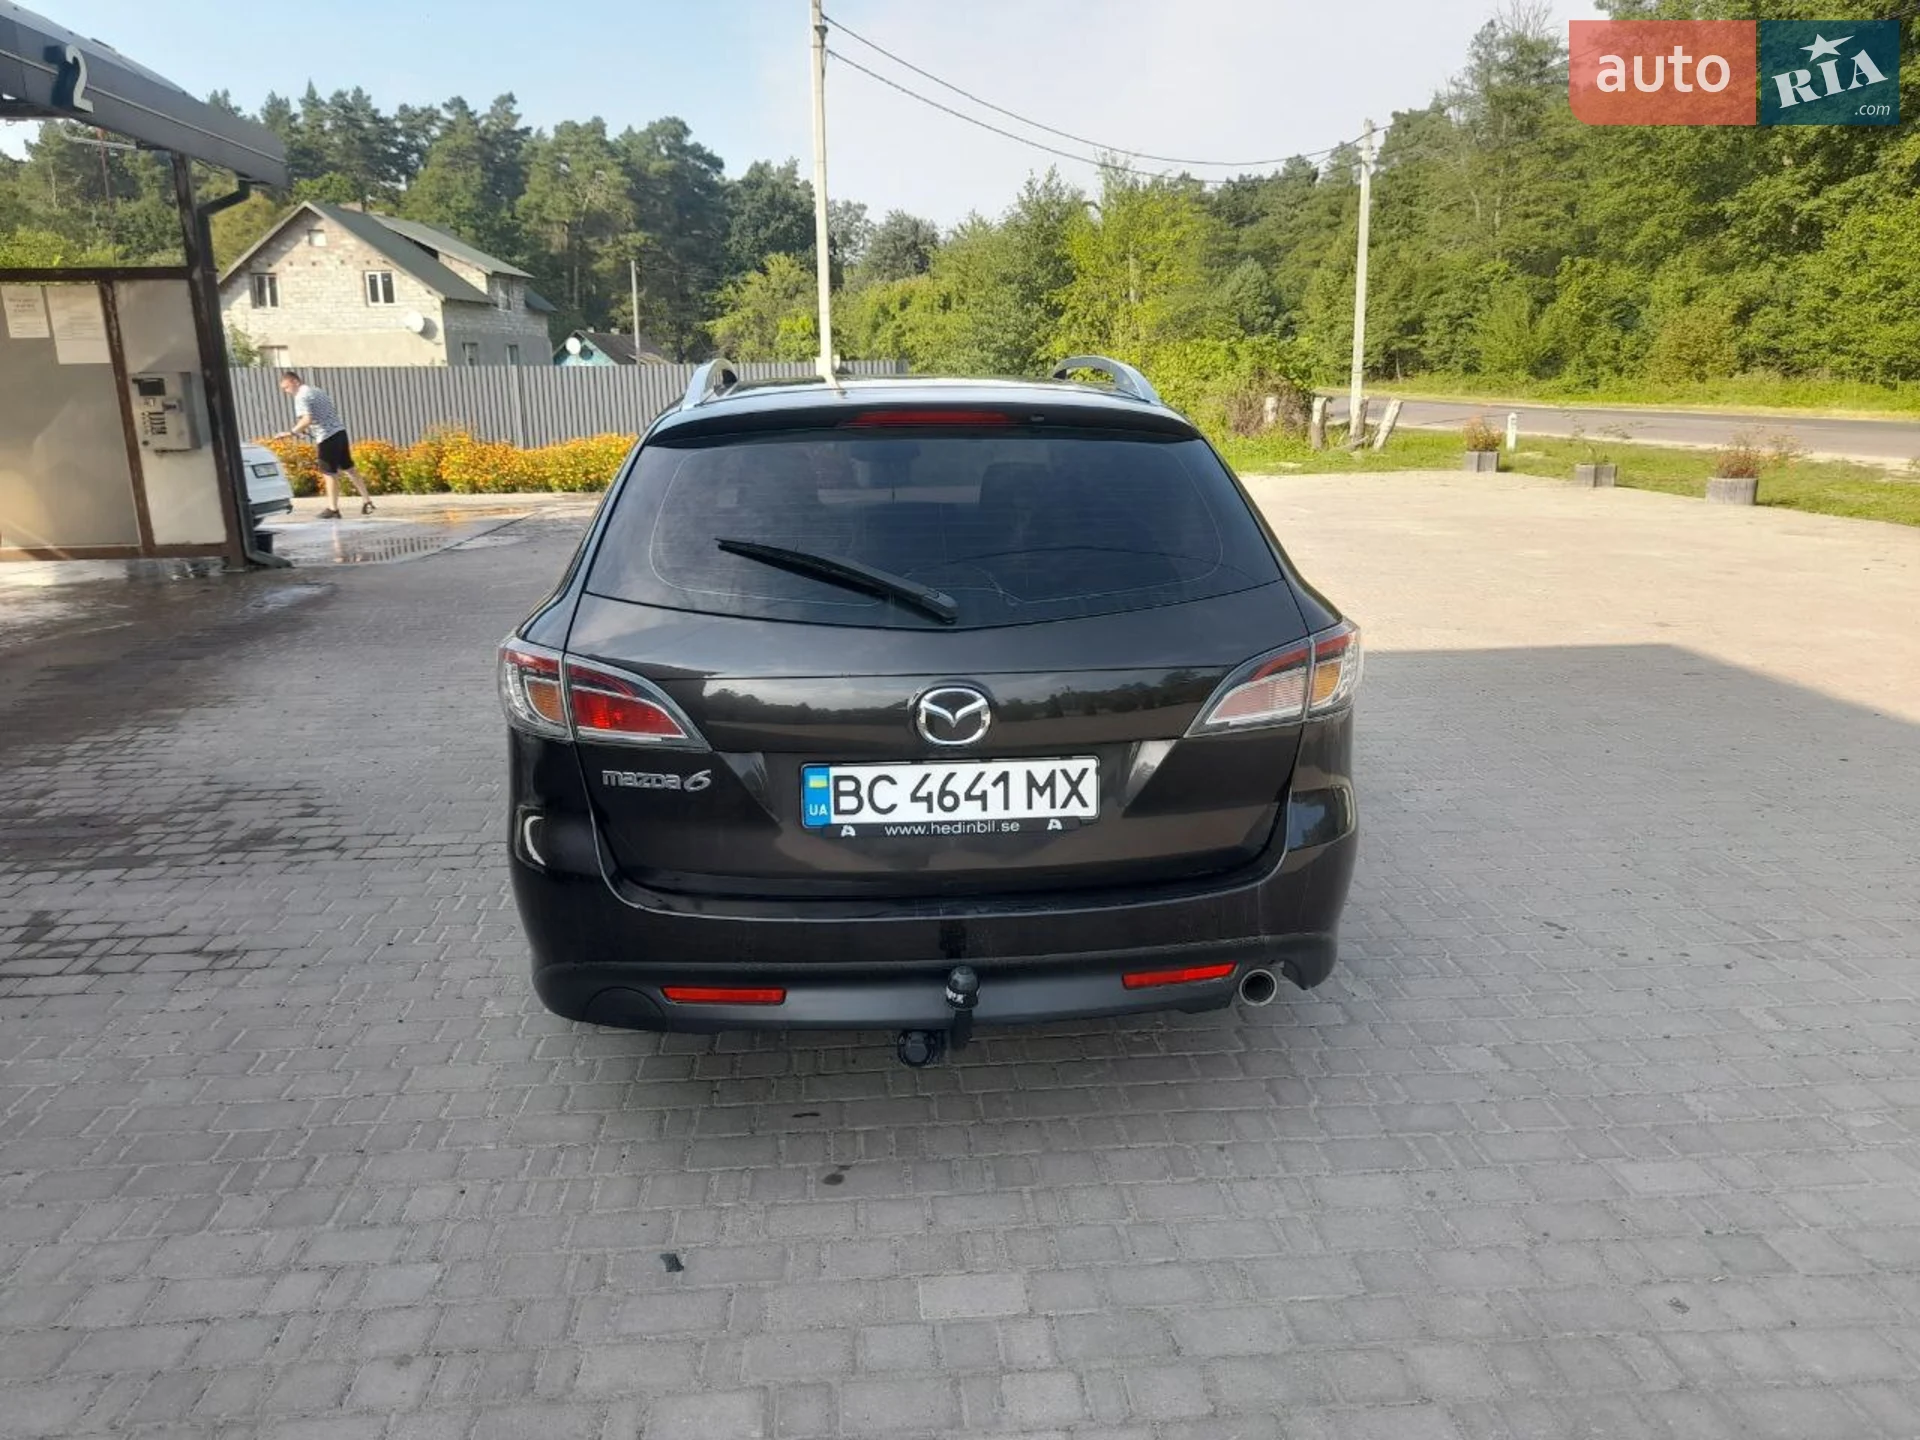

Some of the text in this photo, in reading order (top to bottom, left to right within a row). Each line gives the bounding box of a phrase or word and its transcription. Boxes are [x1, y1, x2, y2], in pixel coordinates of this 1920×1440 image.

[65, 44, 94, 113] 2
[809, 803, 828, 816] UA
[833, 767, 1089, 816] BC 4641 MX
